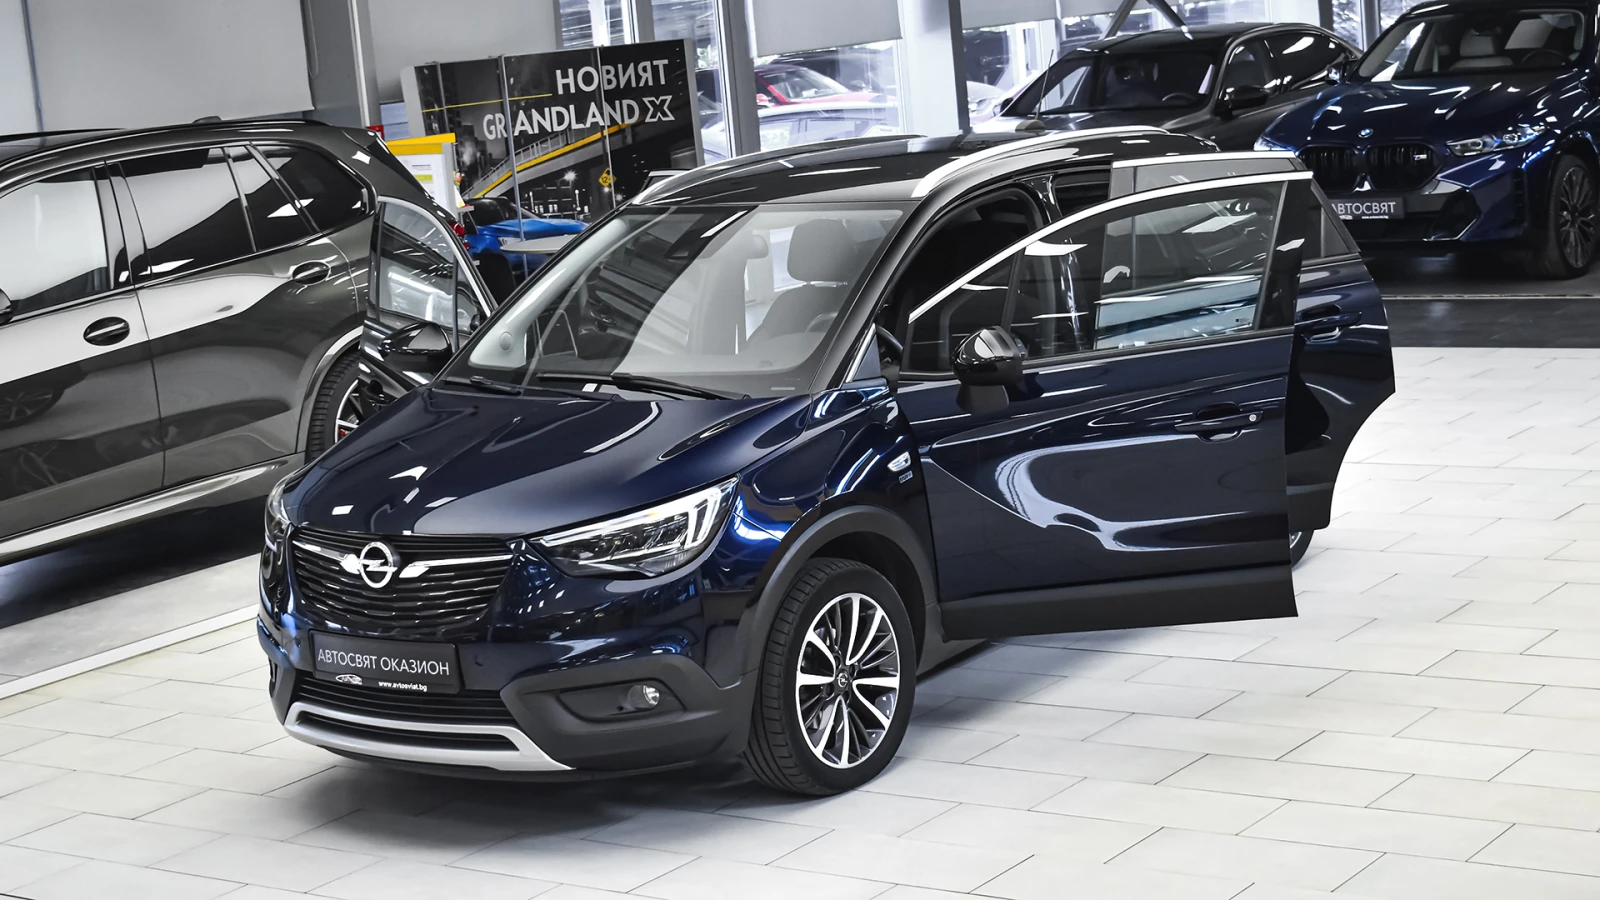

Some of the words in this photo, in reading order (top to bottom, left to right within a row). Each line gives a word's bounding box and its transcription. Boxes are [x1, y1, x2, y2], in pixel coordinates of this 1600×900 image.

[555, 59, 669, 95] НОВИЯТ
[483, 100, 640, 141] GRANDLAND
[642, 95, 675, 123] X
[317, 648, 378, 669] АВТОСВЯТ
[380, 656, 450, 676] ОКАЗИОН
